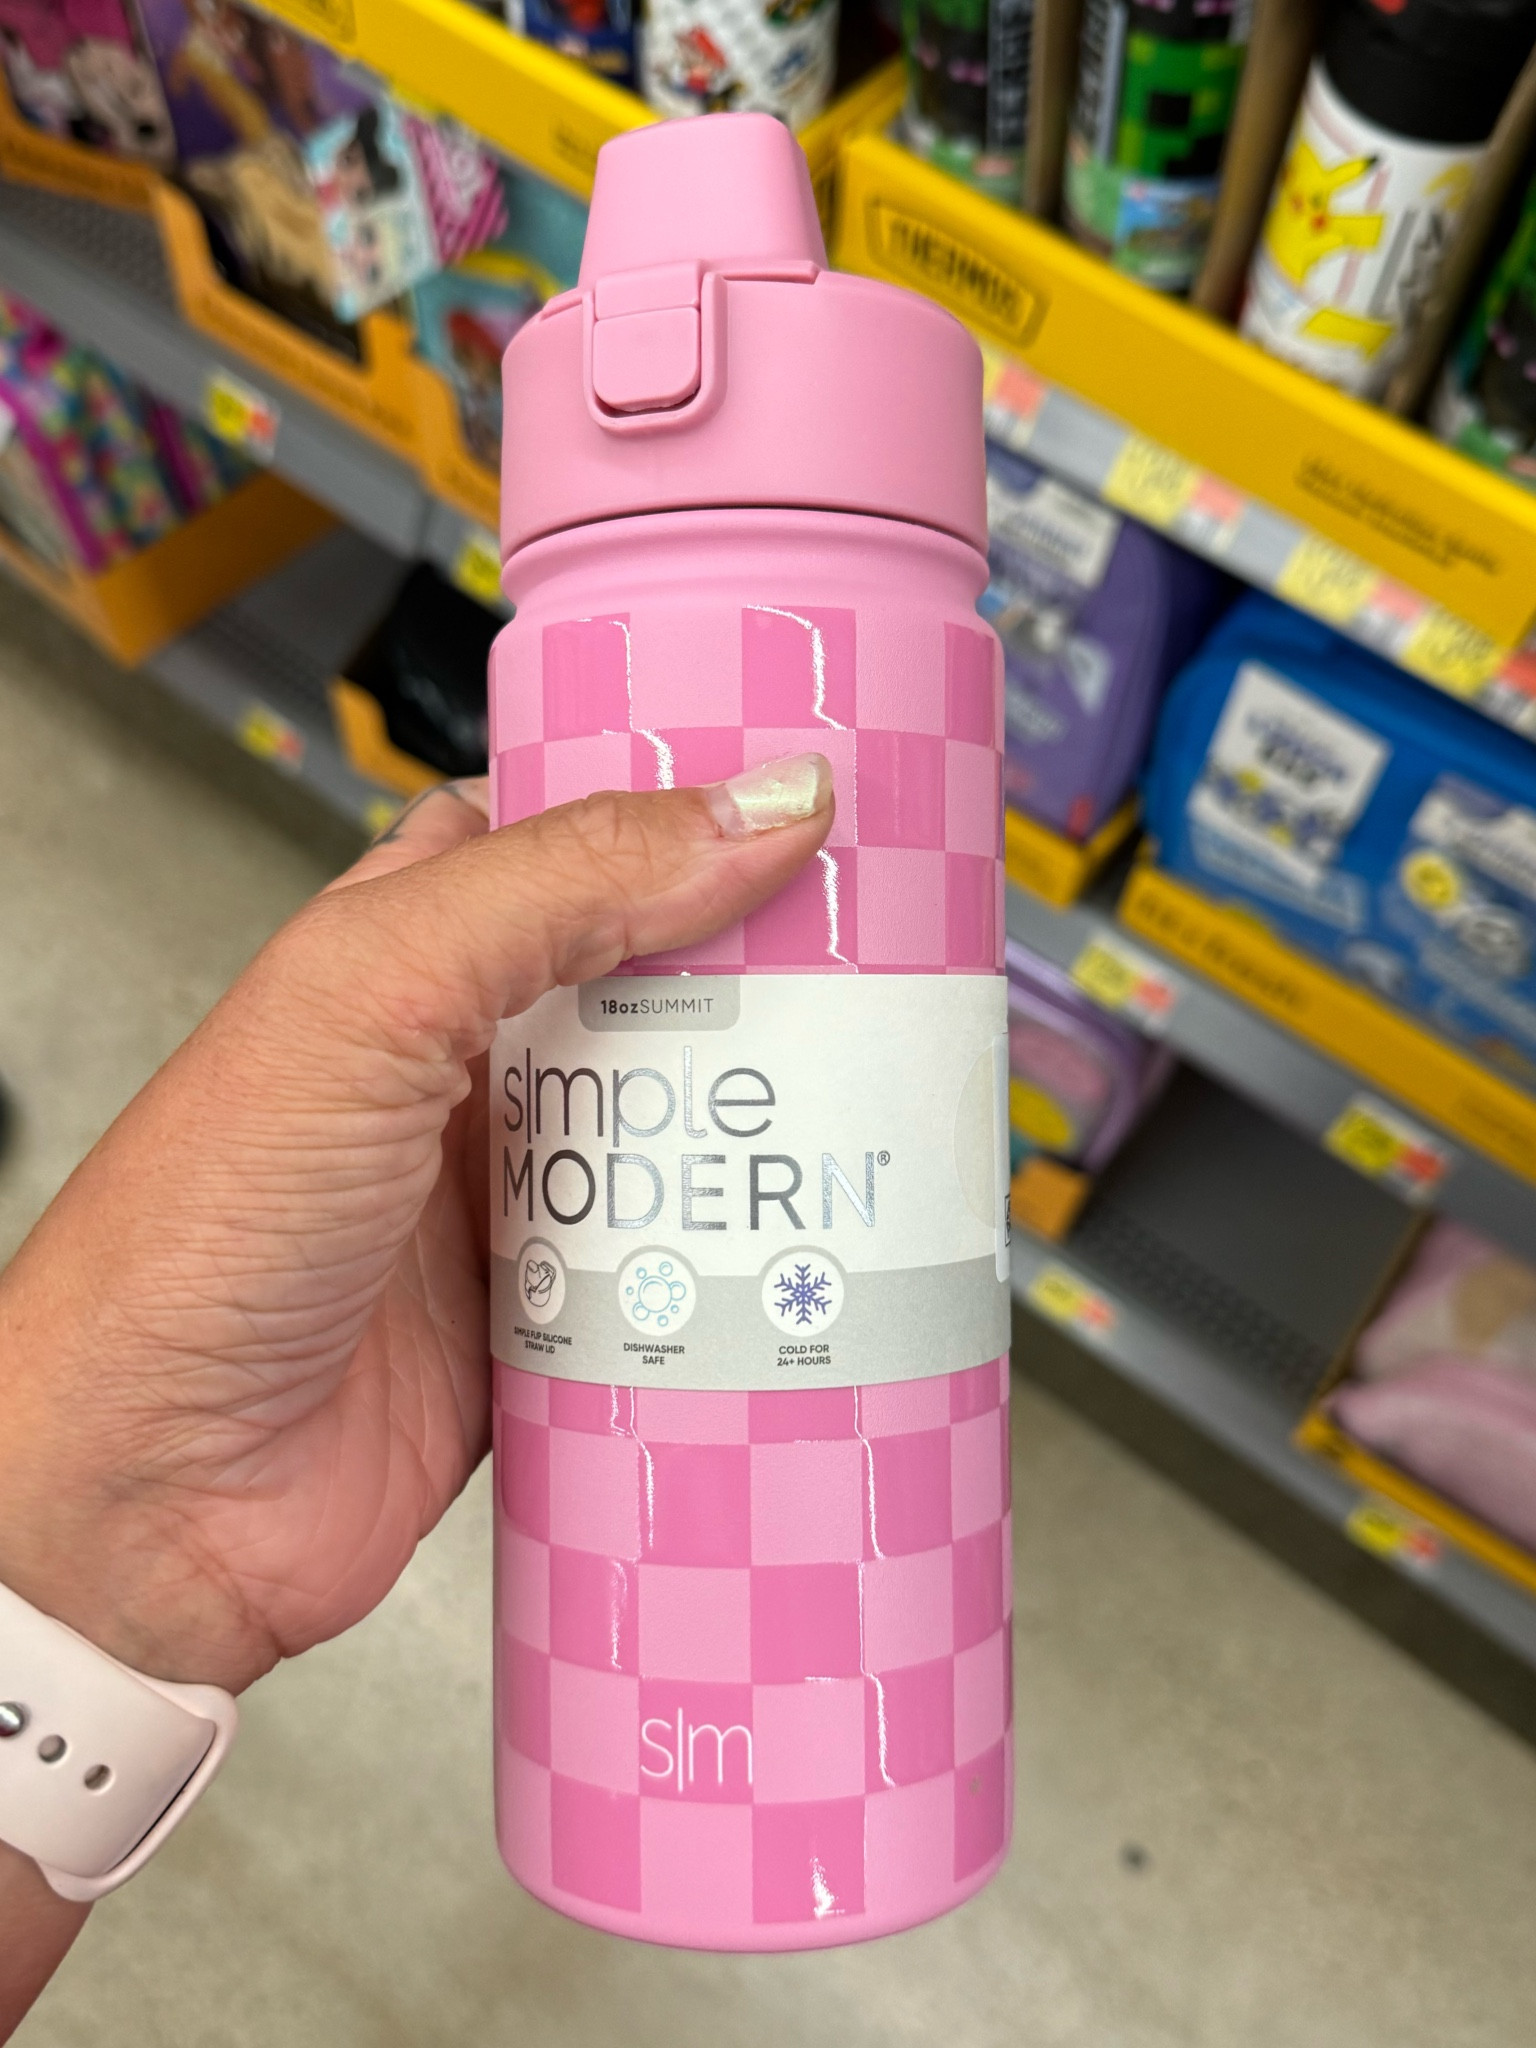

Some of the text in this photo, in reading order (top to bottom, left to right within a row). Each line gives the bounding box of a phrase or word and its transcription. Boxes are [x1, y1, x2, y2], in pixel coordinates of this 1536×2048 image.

[530, 1330, 542, 1340] FLIP
[543, 1332, 572, 1346] SILICONE
[525, 1340, 556, 1354] STRAW LID
[623, 1342, 685, 1354] DISHWASHER
[778, 1344, 830, 1355] COLD FOR
[642, 1355, 665, 1365] SAFE
[777, 1355, 832, 1367] 24+ HOURS
